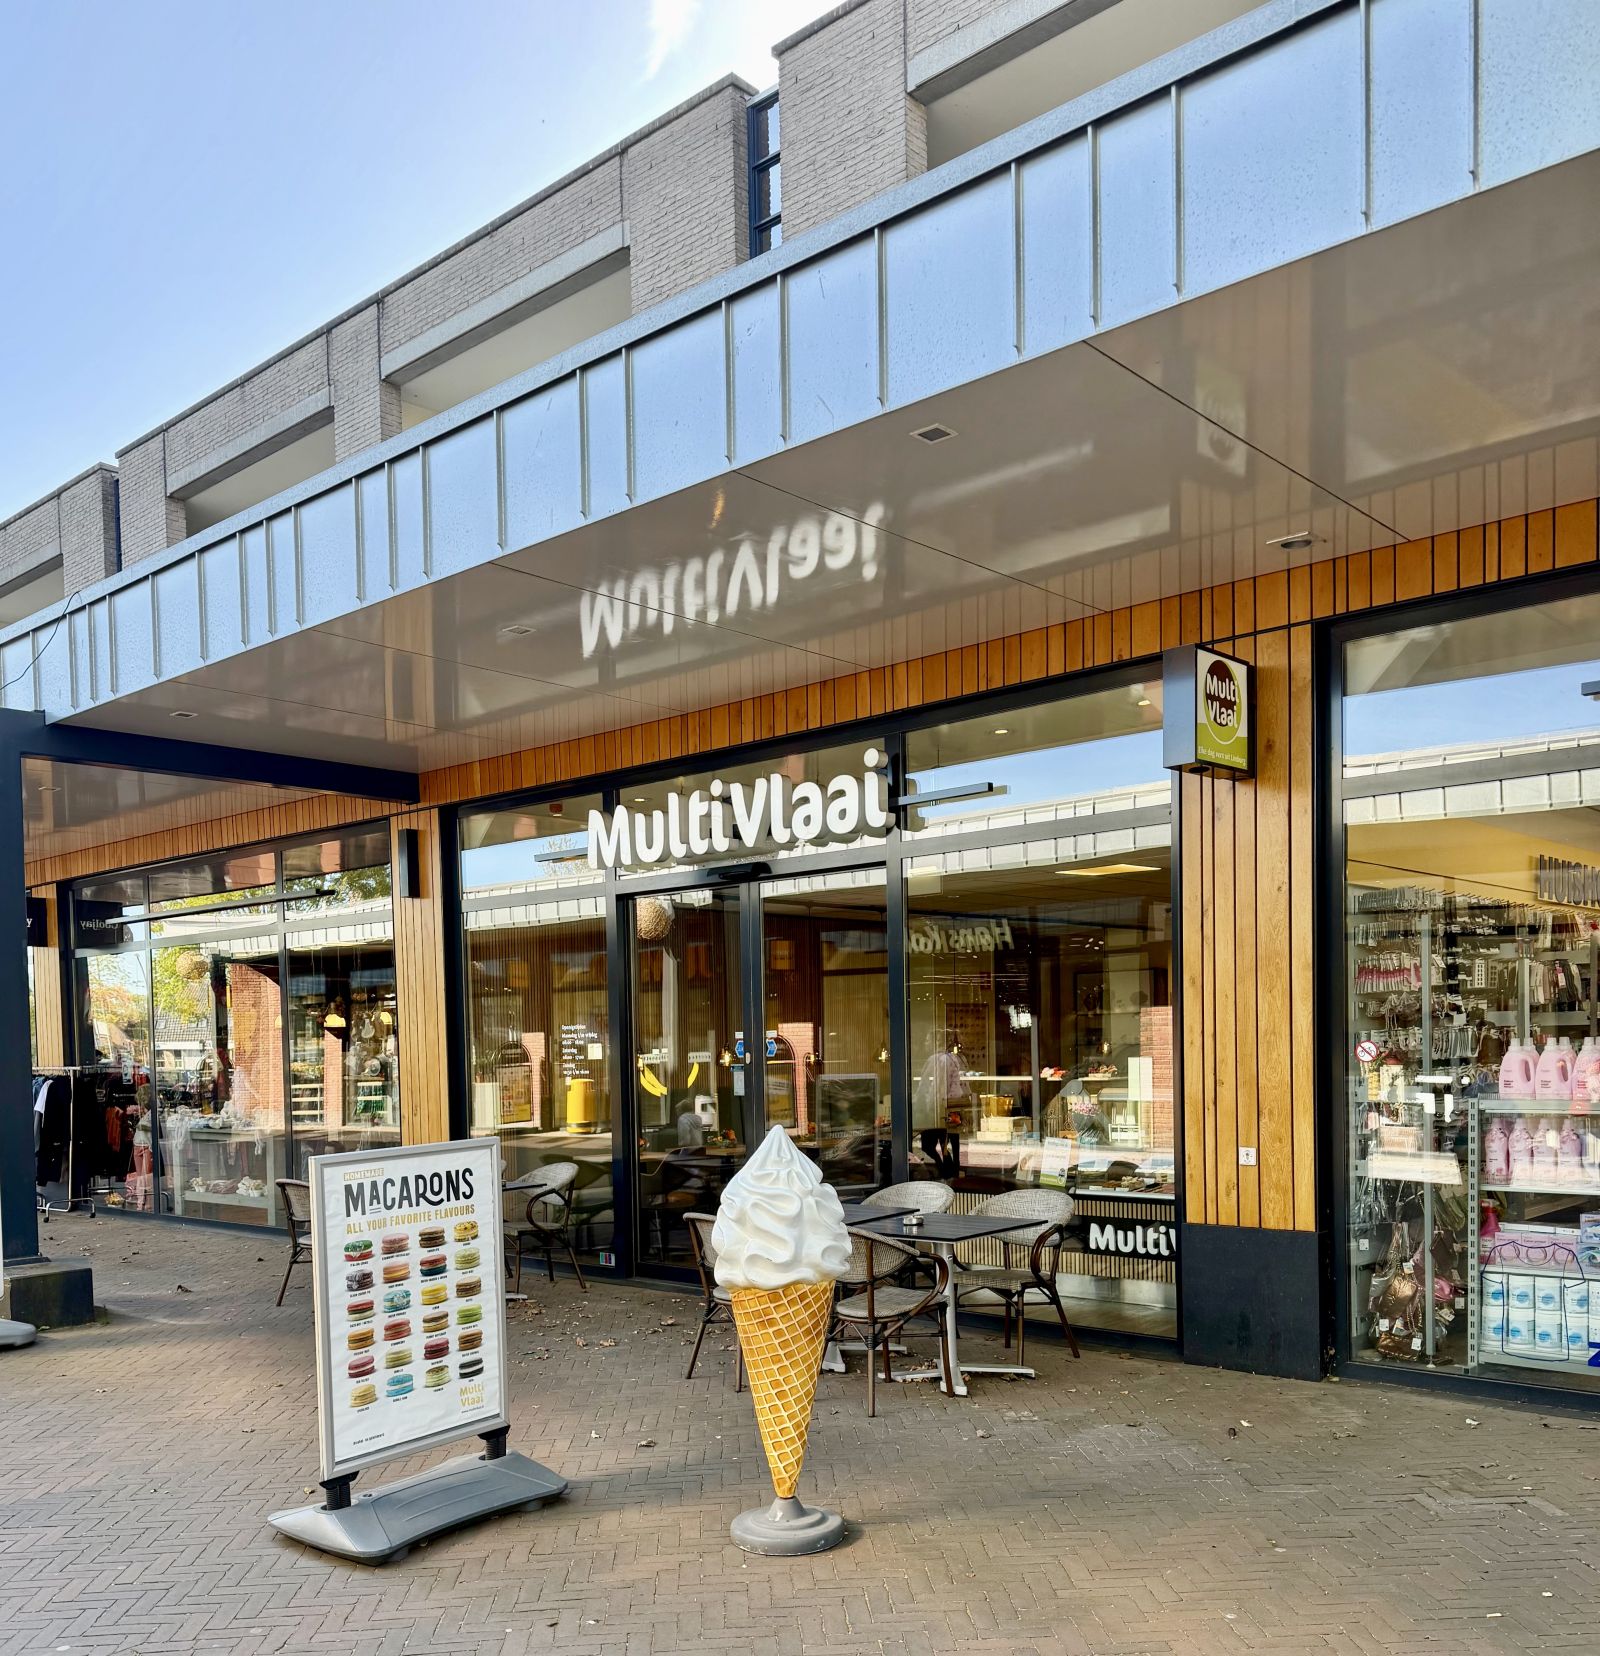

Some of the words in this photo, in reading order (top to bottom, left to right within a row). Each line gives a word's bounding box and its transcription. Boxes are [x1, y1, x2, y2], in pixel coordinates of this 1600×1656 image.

[1206, 673, 1239, 703] Multi
[1207, 699, 1238, 729] Vlaai
[588, 748, 889, 870] MultiVlaai
[1539, 854, 1600, 908] HUISH
[344, 1168, 385, 1181] HOMEMADE
[344, 1167, 474, 1218] MACARONS
[346, 1223, 364, 1235] ALL
[367, 1218, 388, 1232] YOUR
[390, 1212, 432, 1227] FAVORITE
[434, 1204, 476, 1220] FLAVOURS
[1089, 1222, 1176, 1257] Multi
[459, 1382, 485, 1397] Multi
[460, 1392, 484, 1408] Vlaai
